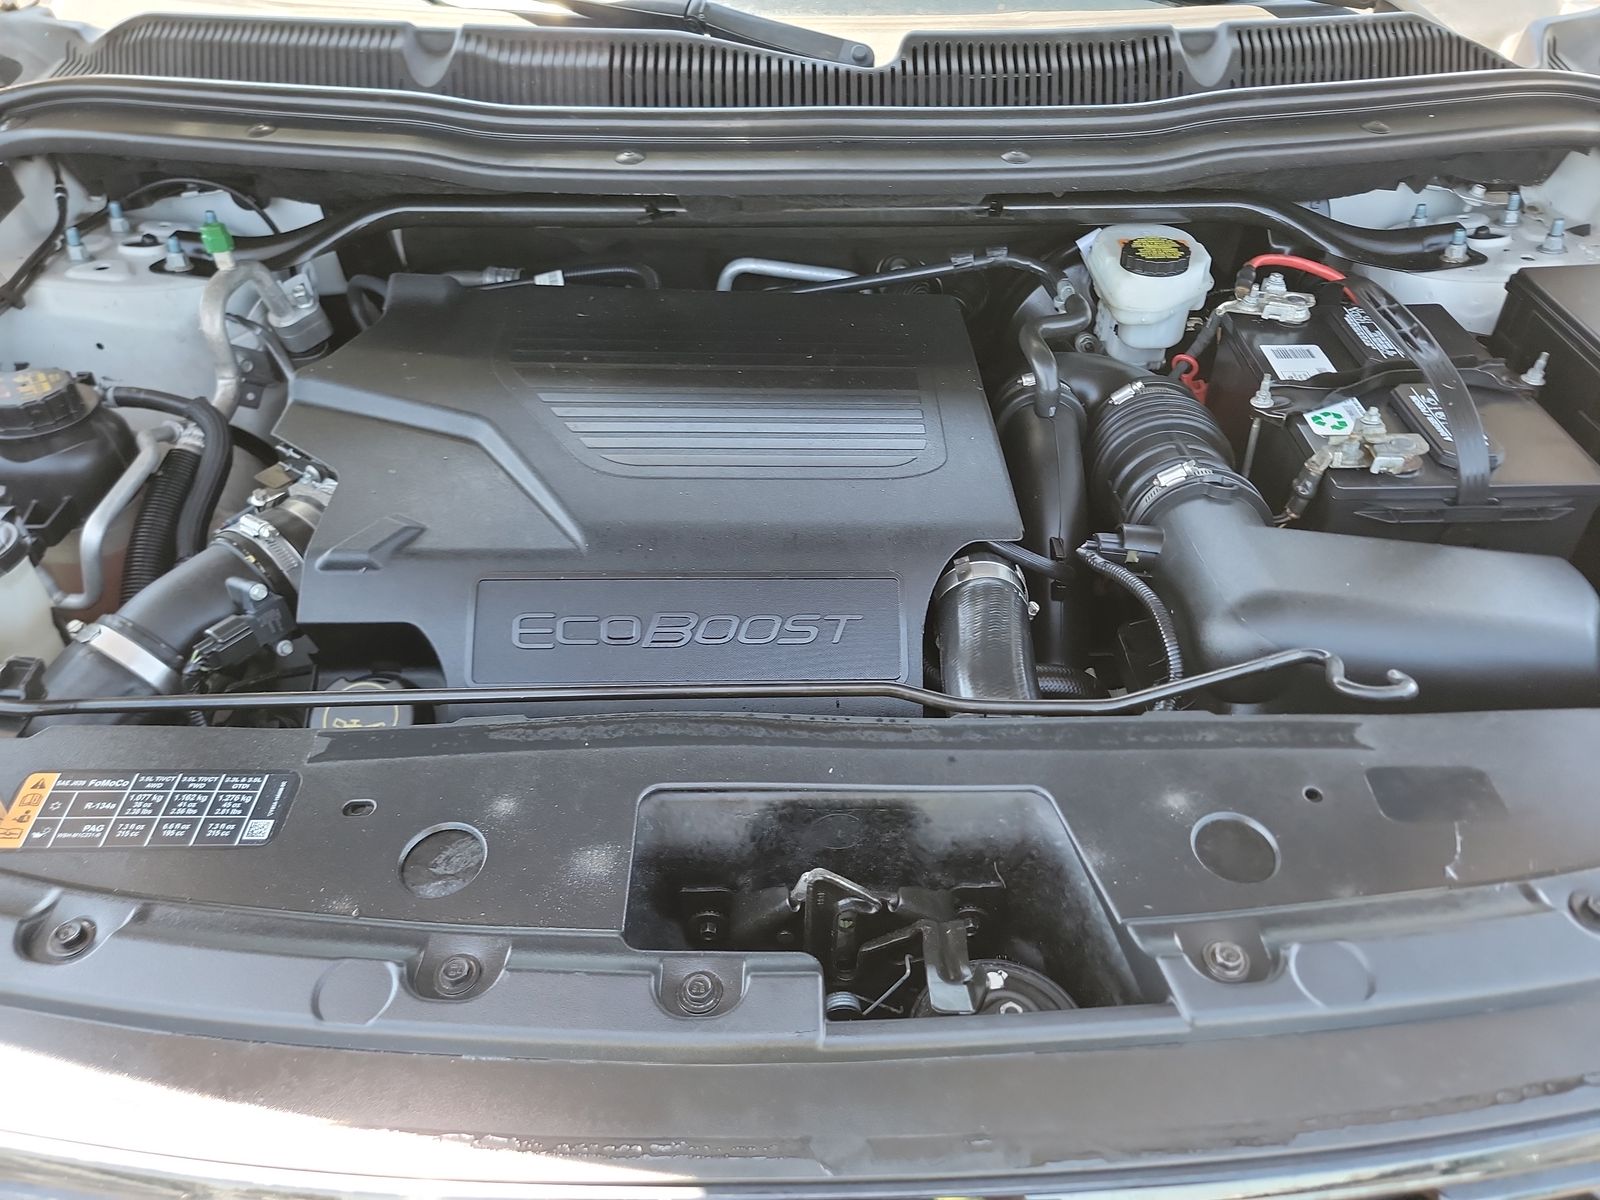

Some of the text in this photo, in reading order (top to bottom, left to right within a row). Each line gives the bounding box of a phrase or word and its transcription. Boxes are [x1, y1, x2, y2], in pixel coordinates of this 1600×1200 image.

[88, 779, 130, 787] FoMoCo
[129, 793, 164, 803] 1.077 kg
[196, 794, 208, 803] kg
[240, 795, 253, 804] kg
[81, 824, 105, 832] PAG
